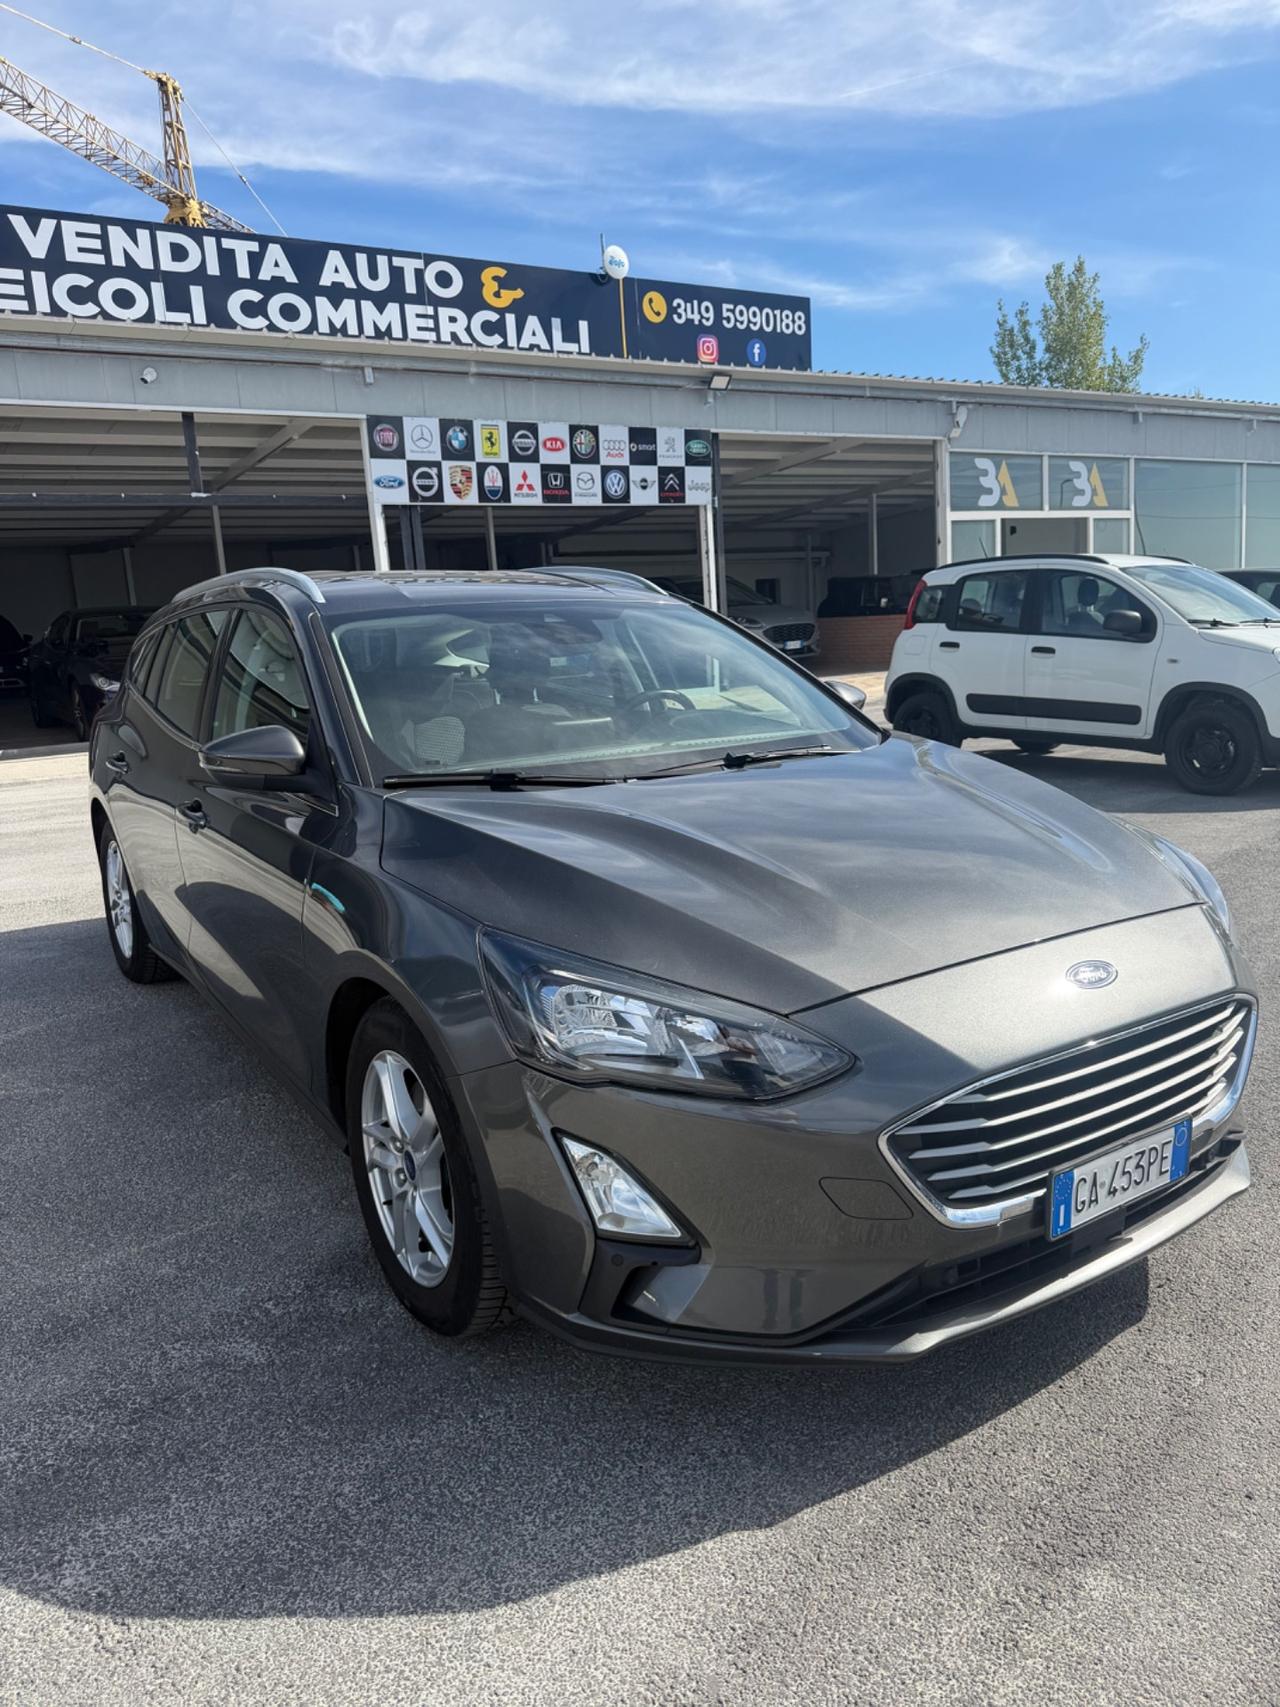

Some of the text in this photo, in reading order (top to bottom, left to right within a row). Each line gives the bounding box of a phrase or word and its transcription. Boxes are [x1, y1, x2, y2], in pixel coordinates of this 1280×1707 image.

[7, 213, 525, 309] VENDITA AUTO &
[0, 267, 591, 355] EICOLI COMMERCIALI
[672, 298, 807, 336] 349 5990188
[545, 441, 563, 449] KIA
[638, 443, 656, 451] smart
[1075, 1139, 1173, 1213] GA 453PE
